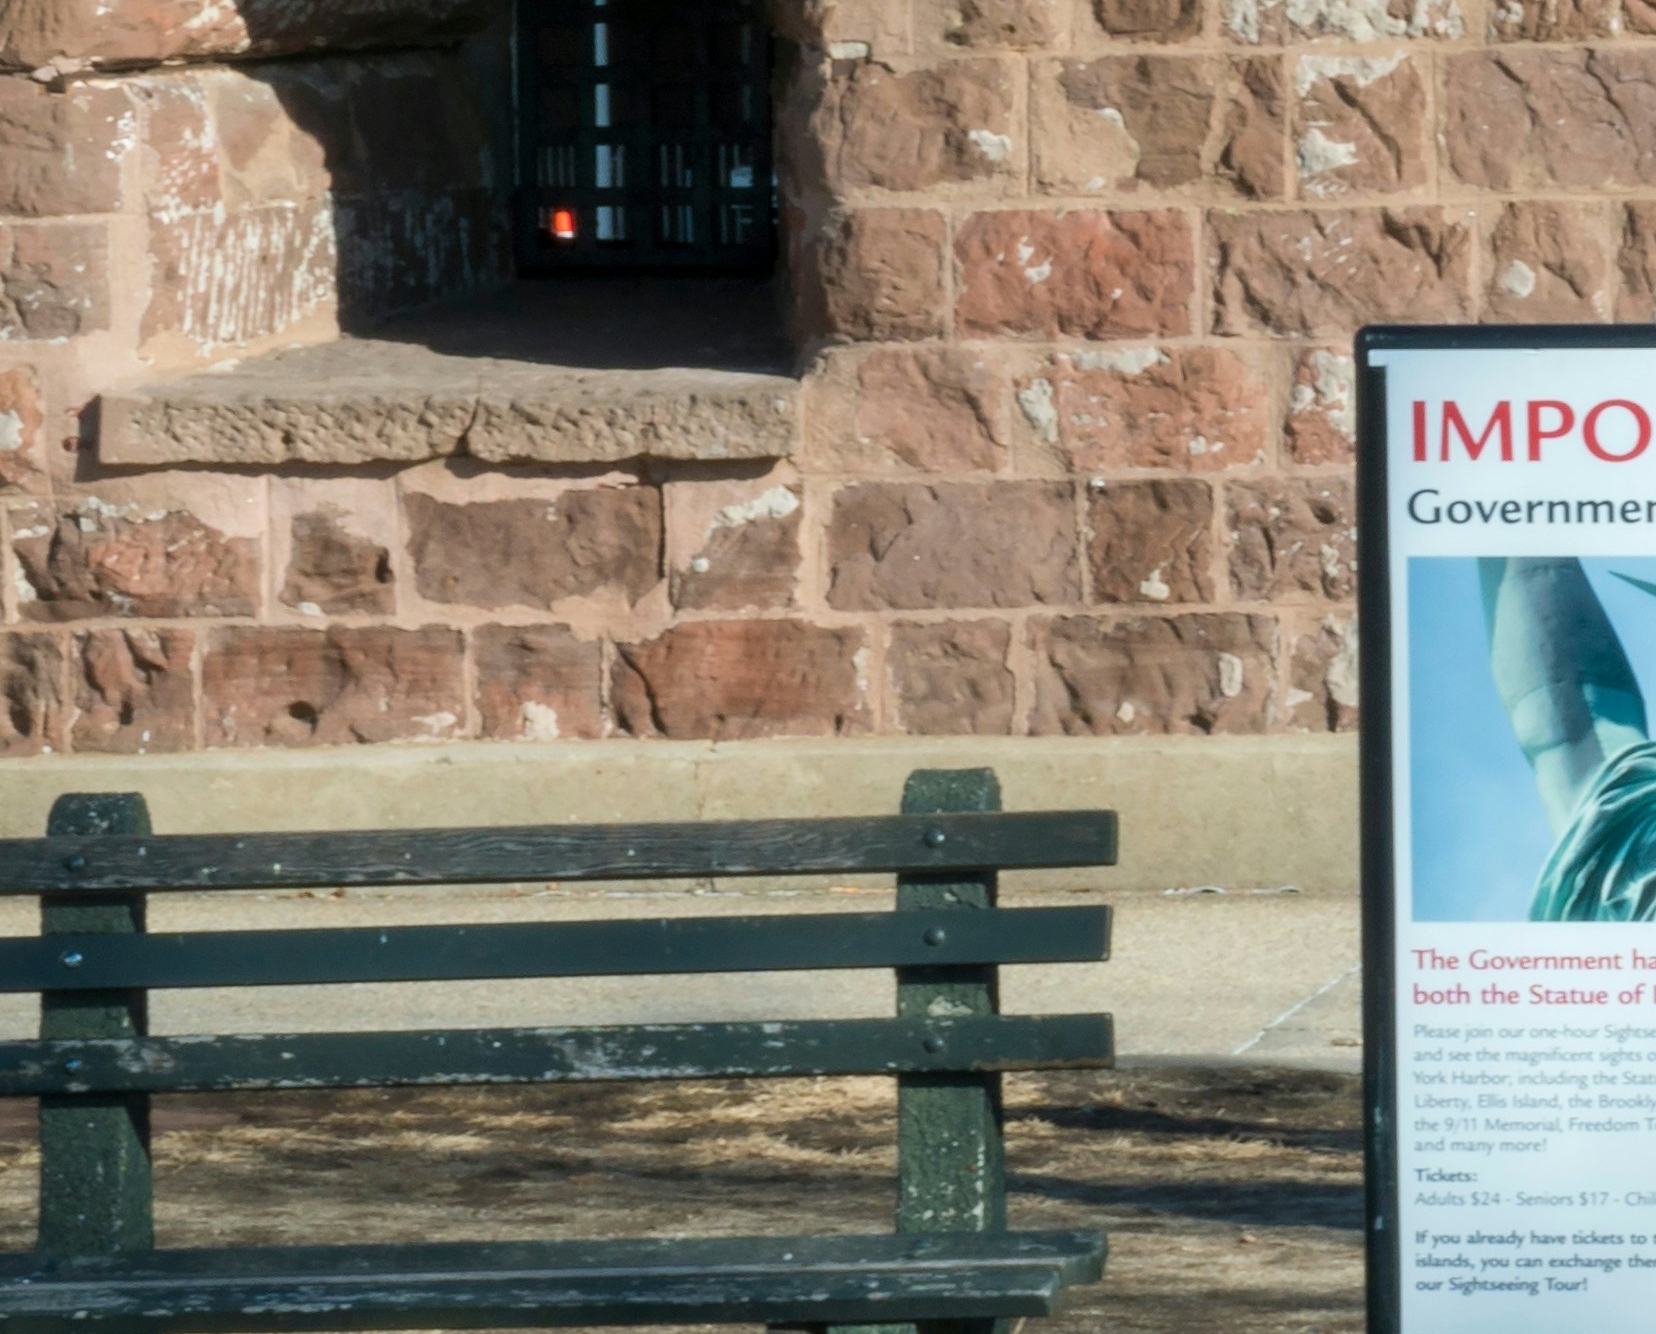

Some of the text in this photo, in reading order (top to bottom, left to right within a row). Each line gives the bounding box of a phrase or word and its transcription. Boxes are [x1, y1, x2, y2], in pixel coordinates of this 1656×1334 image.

[1411, 948, 1460, 970] The
[1468, 949, 1623, 970] Government
[1413, 983, 1471, 1005] both
[1480, 983, 1520, 1005] the
[1529, 984, 1609, 1005] Statue
[1618, 983, 1646, 1005] of
[1413, 1024, 1461, 1038] Please
[1463, 1024, 1493, 1044] join
[1498, 1028, 1526, 1038] our
[1529, 1024, 1600, 1038] one-hour
[1413, 1047, 1443, 1062] and
[1448, 1051, 1472, 1062] see
[1475, 1047, 1501, 1062] the
[1505, 1047, 1594, 1067] magnificent
[1599, 1047, 1643, 1067] sights
[1412, 1071, 1448, 1085] York
[1518, 1071, 1589, 1090] including
[1592, 1071, 1618, 1085] the
[1414, 1094, 1472, 1112] Liberty,
[1477, 1094, 1508, 1108] Ellis
[1512, 1094, 1563, 1110] Island,
[1568, 1094, 1593, 1109] the
[1414, 1117, 1439, 1131] the
[1444, 1117, 1477, 1133] 9/11
[1568, 1117, 1640, 1132] Freedom
[1414, 1138, 1547, 1156] and many more!
[1414, 1168, 1478, 1182] Tickets:
[1414, 1191, 1466, 1206] Adults
[1470, 1191, 1501, 1206] $24
[1516, 1192, 1574, 1206] Seniors
[1579, 1191, 1609, 1206] $17
[1415, 1230, 1428, 1244] If
[1431, 1235, 1461, 1249] you
[1466, 1230, 1525, 1249] already
[1530, 1230, 1567, 1245] have
[1572, 1230, 1625, 1245] tickets
[1630, 1234, 1648, 1245] to
[1415, 1253, 1475, 1270] islands,
[1480, 1258, 1510, 1272] you
[1515, 1258, 1543, 1268] can
[1548, 1254, 1622, 1273] exchange
[1415, 1277, 1588, 1296] our Sightseeing Tour!
